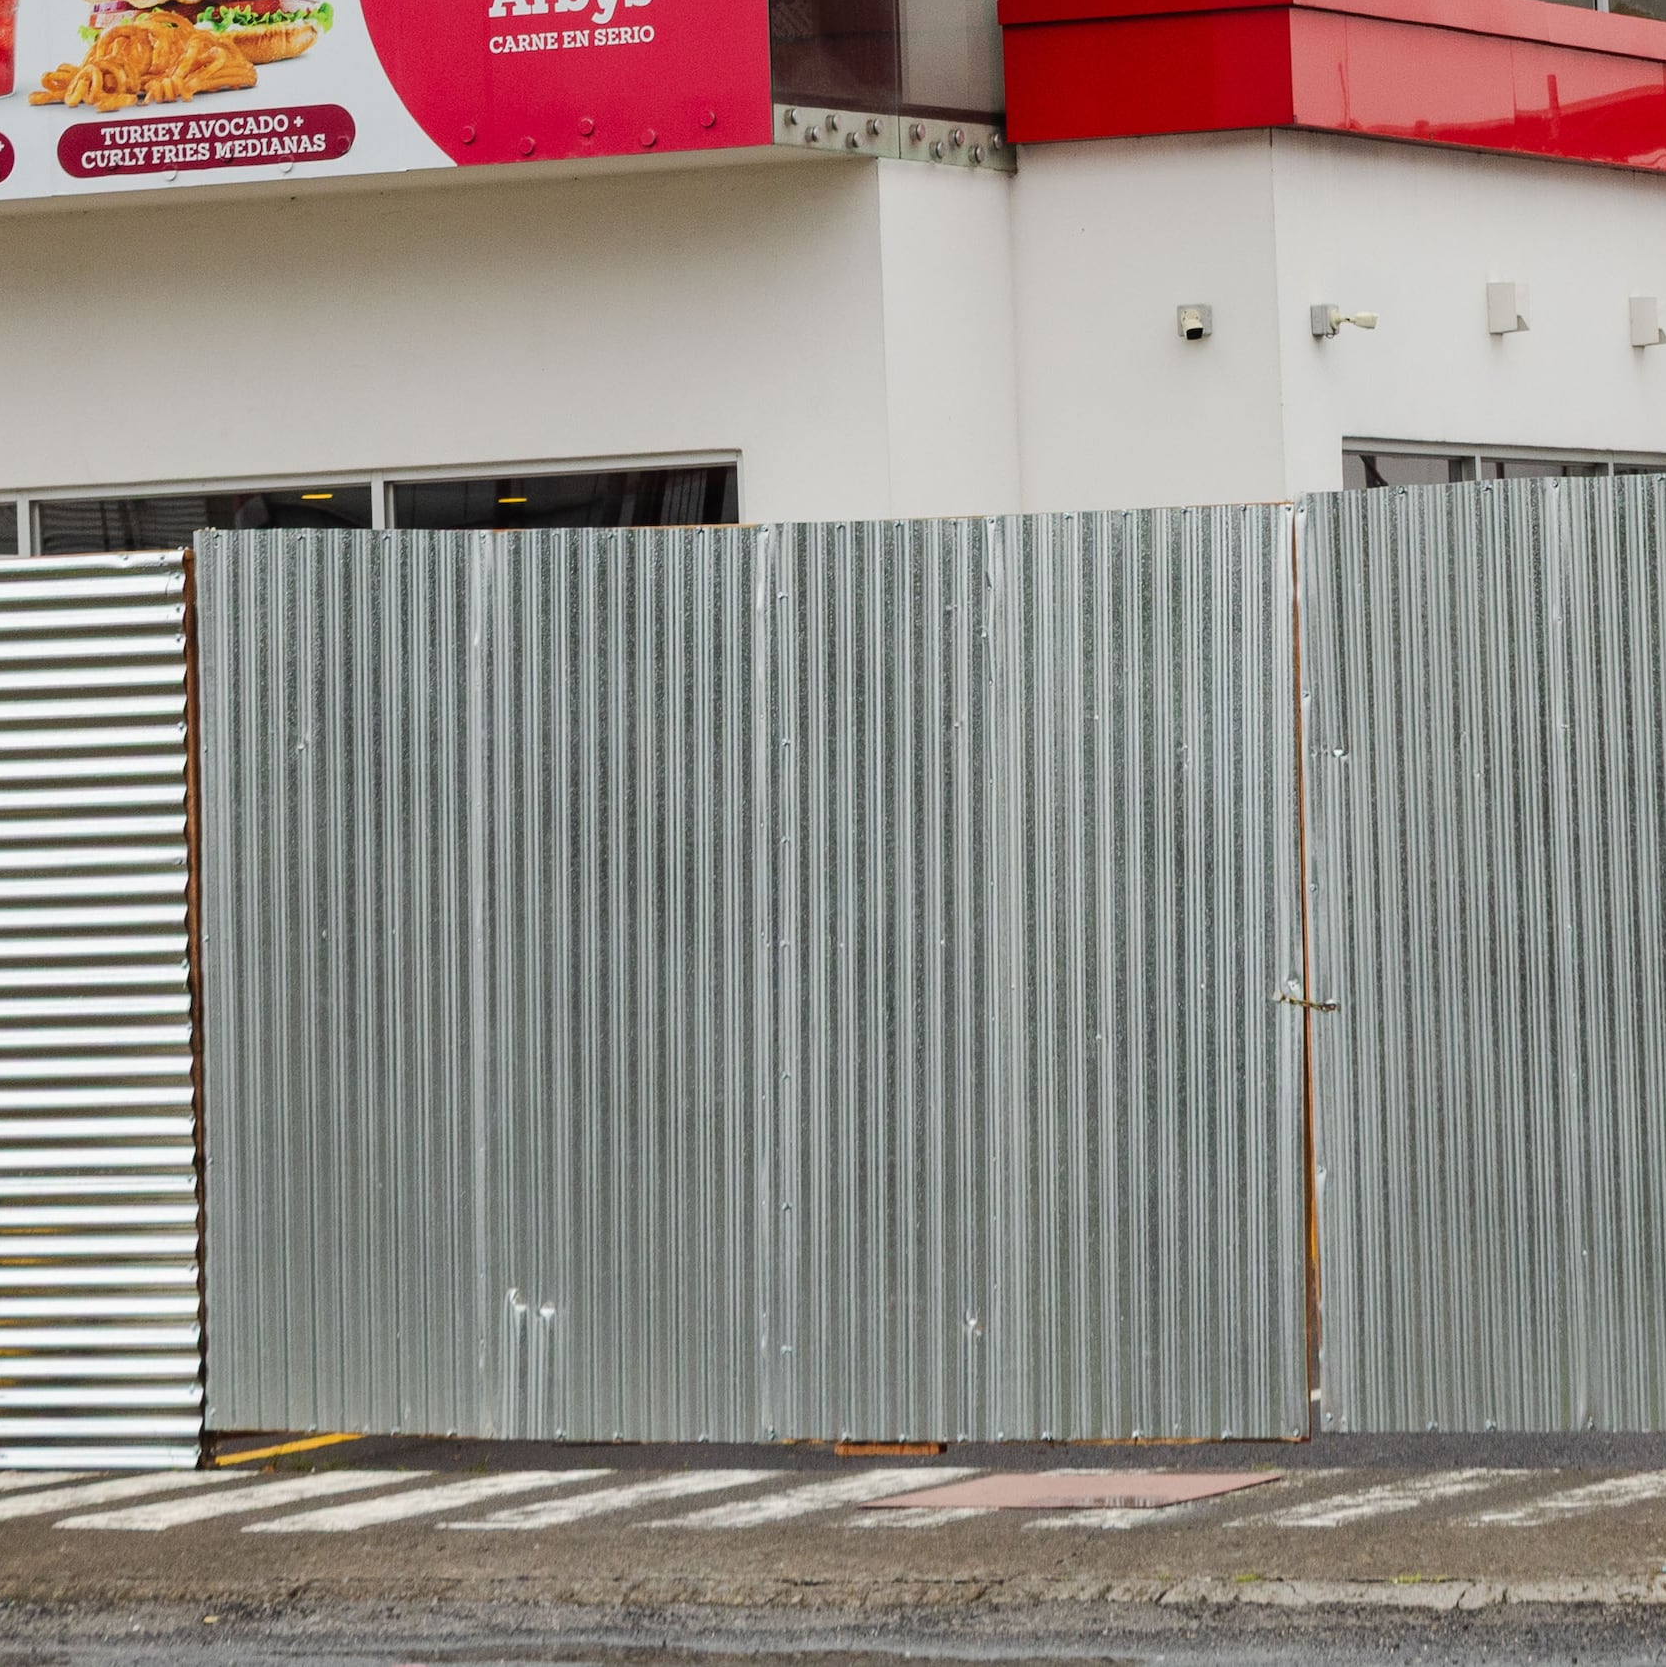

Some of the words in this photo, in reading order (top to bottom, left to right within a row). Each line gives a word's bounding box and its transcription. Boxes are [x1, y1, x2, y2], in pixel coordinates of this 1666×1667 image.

[489, 33, 558, 54] CARNE
[562, 30, 590, 49] EN
[594, 25, 655, 47] SERIO
[101, 122, 184, 146] TURKEY
[186, 114, 289, 139] AVOCADO
[293, 116, 304, 128] +
[81, 146, 150, 170] CURLY
[151, 142, 210, 165] FRIES
[214, 134, 326, 160] MEDIANAS
